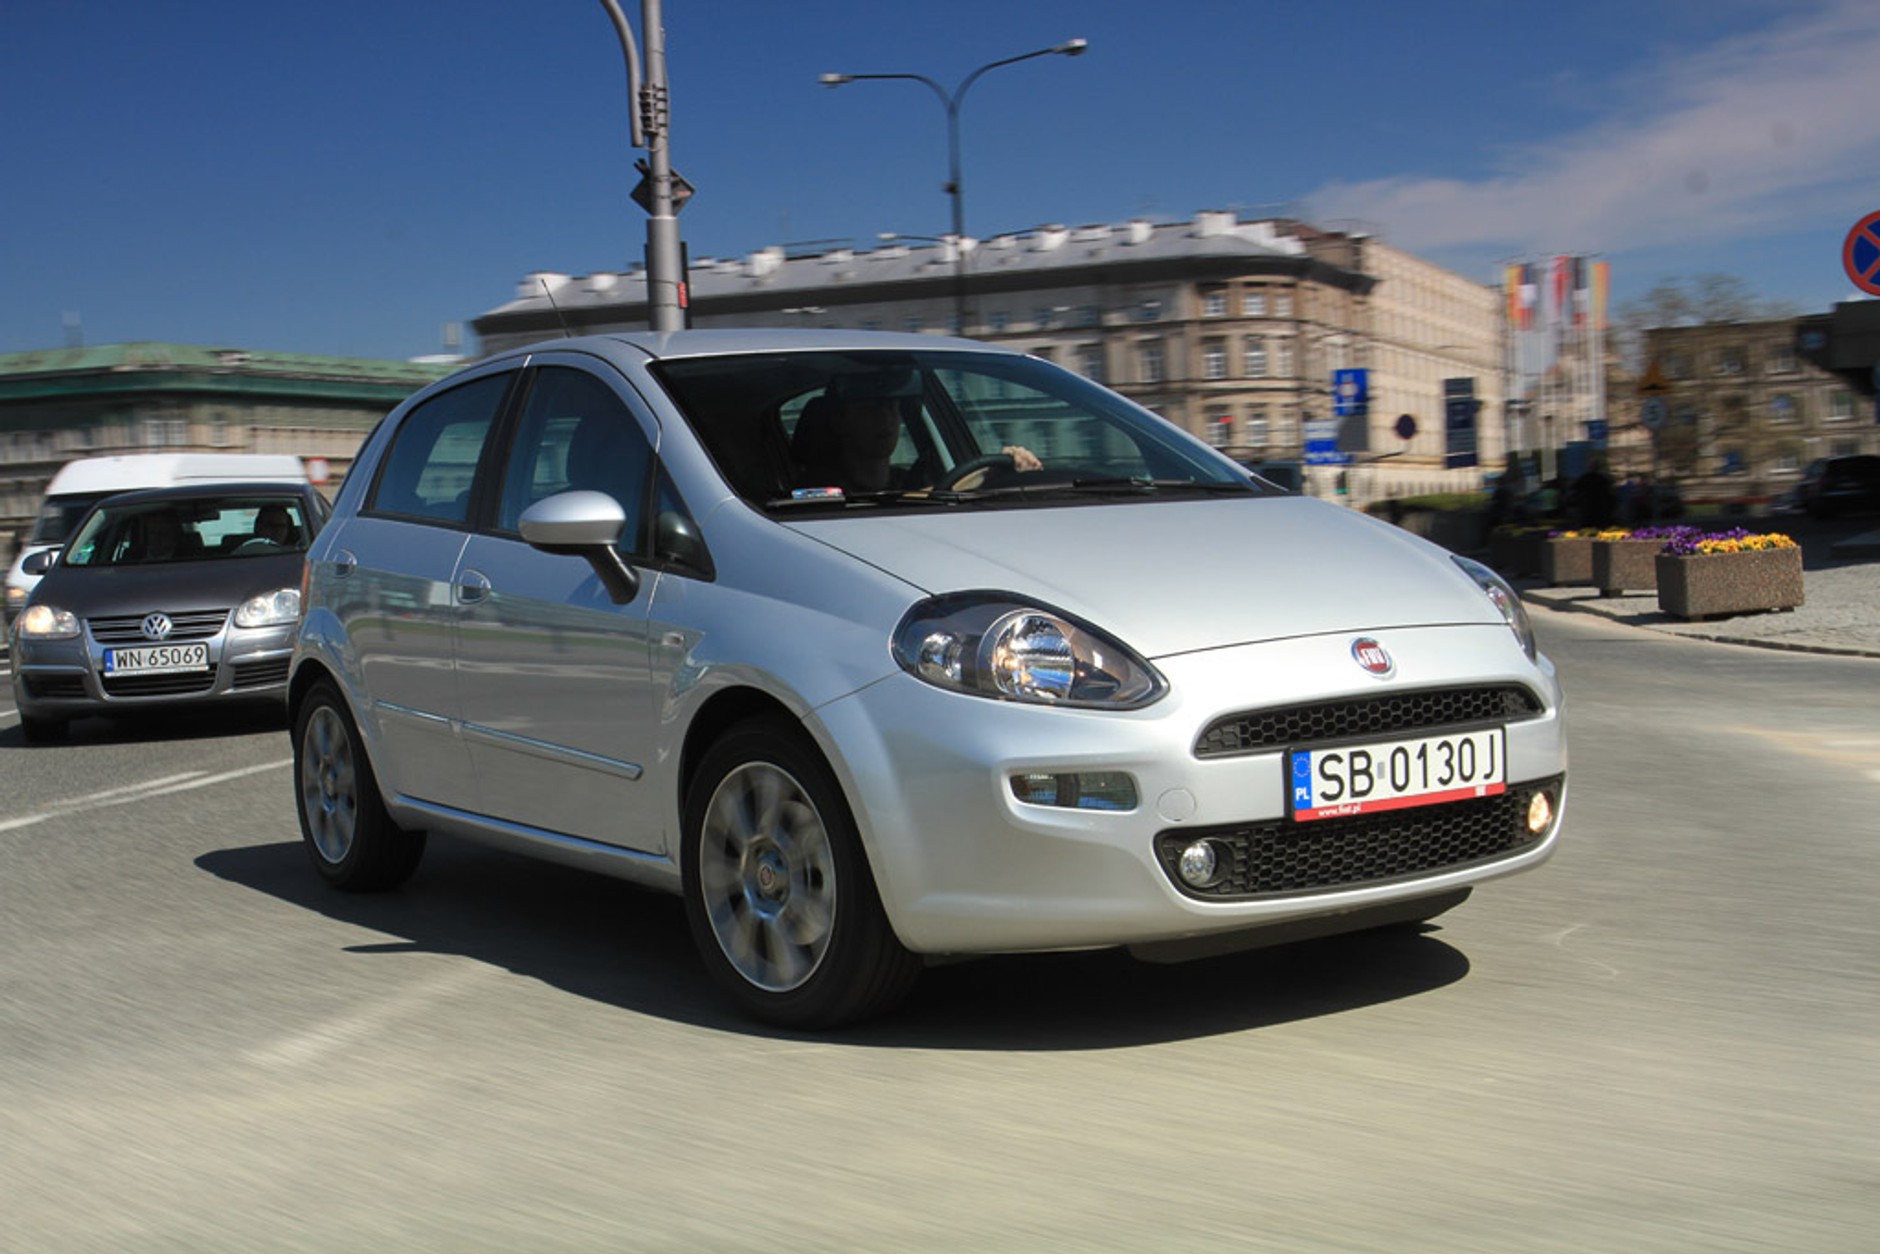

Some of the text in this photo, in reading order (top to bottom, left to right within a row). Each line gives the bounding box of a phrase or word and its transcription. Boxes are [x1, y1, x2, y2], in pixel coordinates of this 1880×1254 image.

[116, 650, 142, 668] WN
[148, 646, 204, 666] 65069
[1319, 734, 1494, 801] SB 0130J
[1295, 787, 1310, 801] PL
